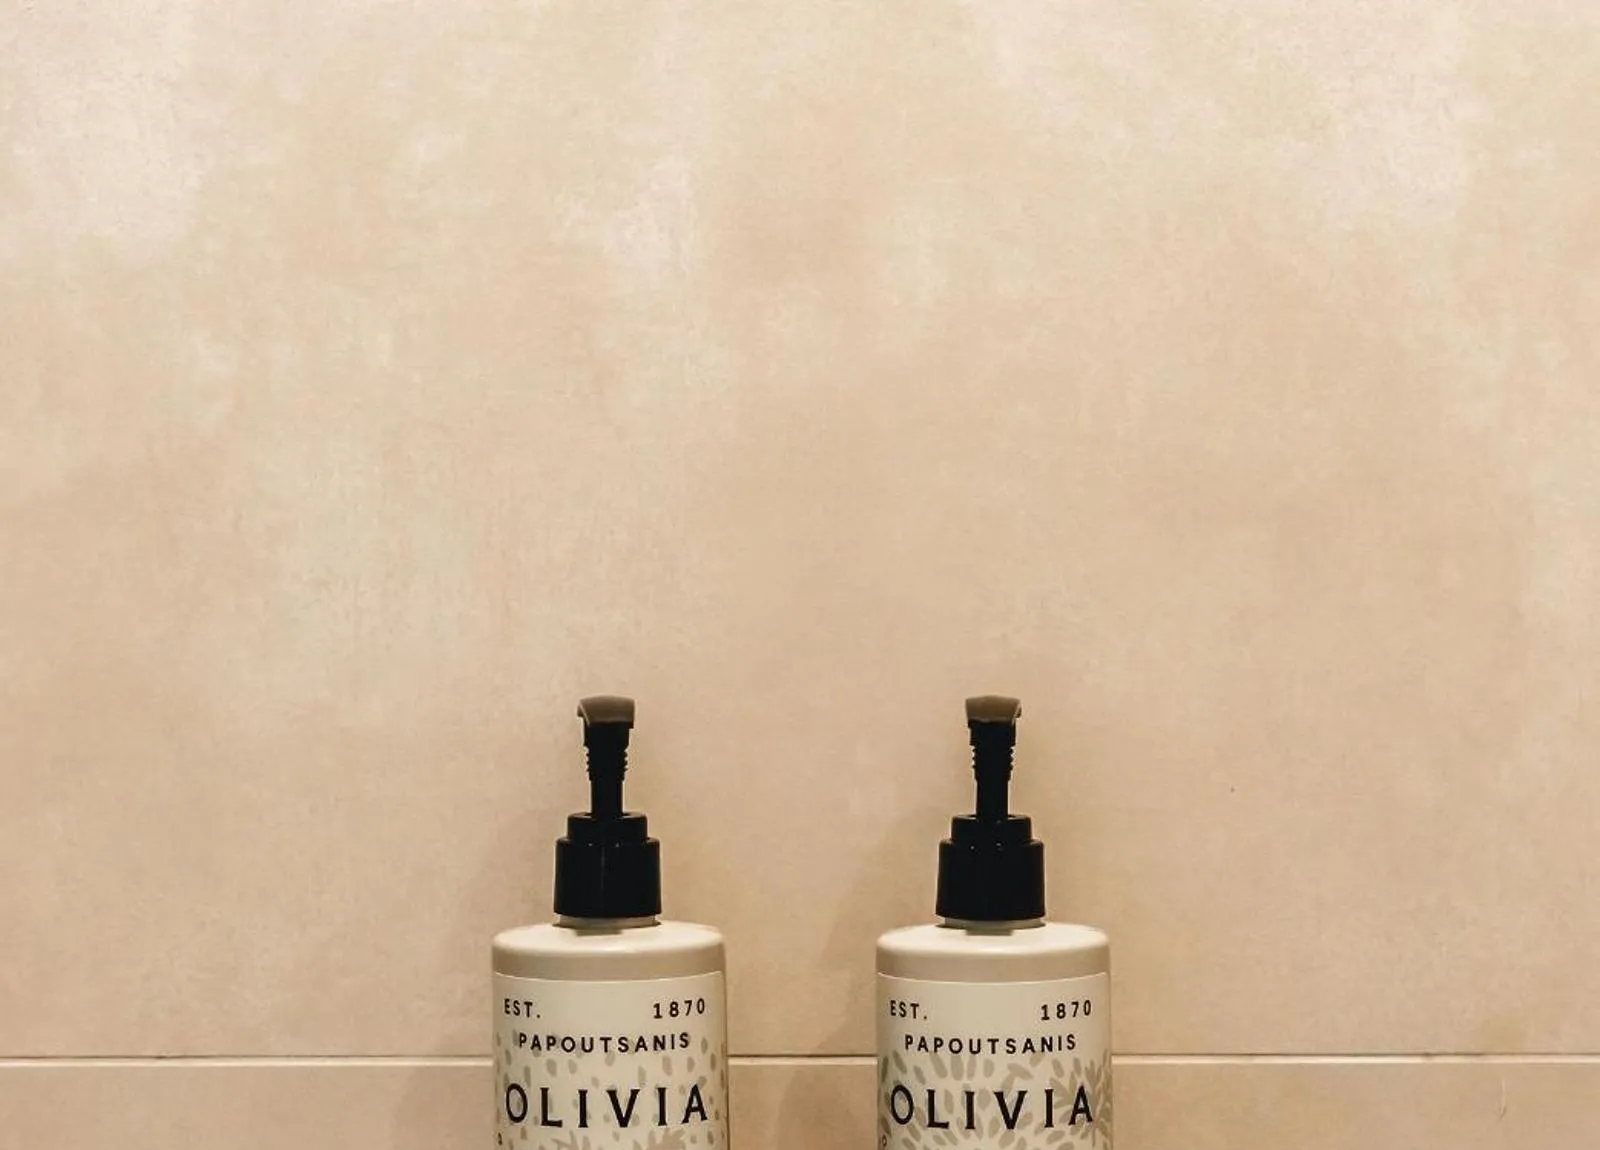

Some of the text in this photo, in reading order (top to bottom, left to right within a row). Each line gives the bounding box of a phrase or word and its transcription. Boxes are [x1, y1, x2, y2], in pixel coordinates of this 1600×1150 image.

[504, 998, 705, 1019] EST. 1870
[890, 1000, 1092, 1021] EST. 1870
[519, 1032, 690, 1053] PAPOUTSANIS
[904, 1033, 1076, 1054] PAPOUTSANIS
[505, 1083, 708, 1128] OLIVIA
[890, 1084, 1094, 1130] OLIVIA
